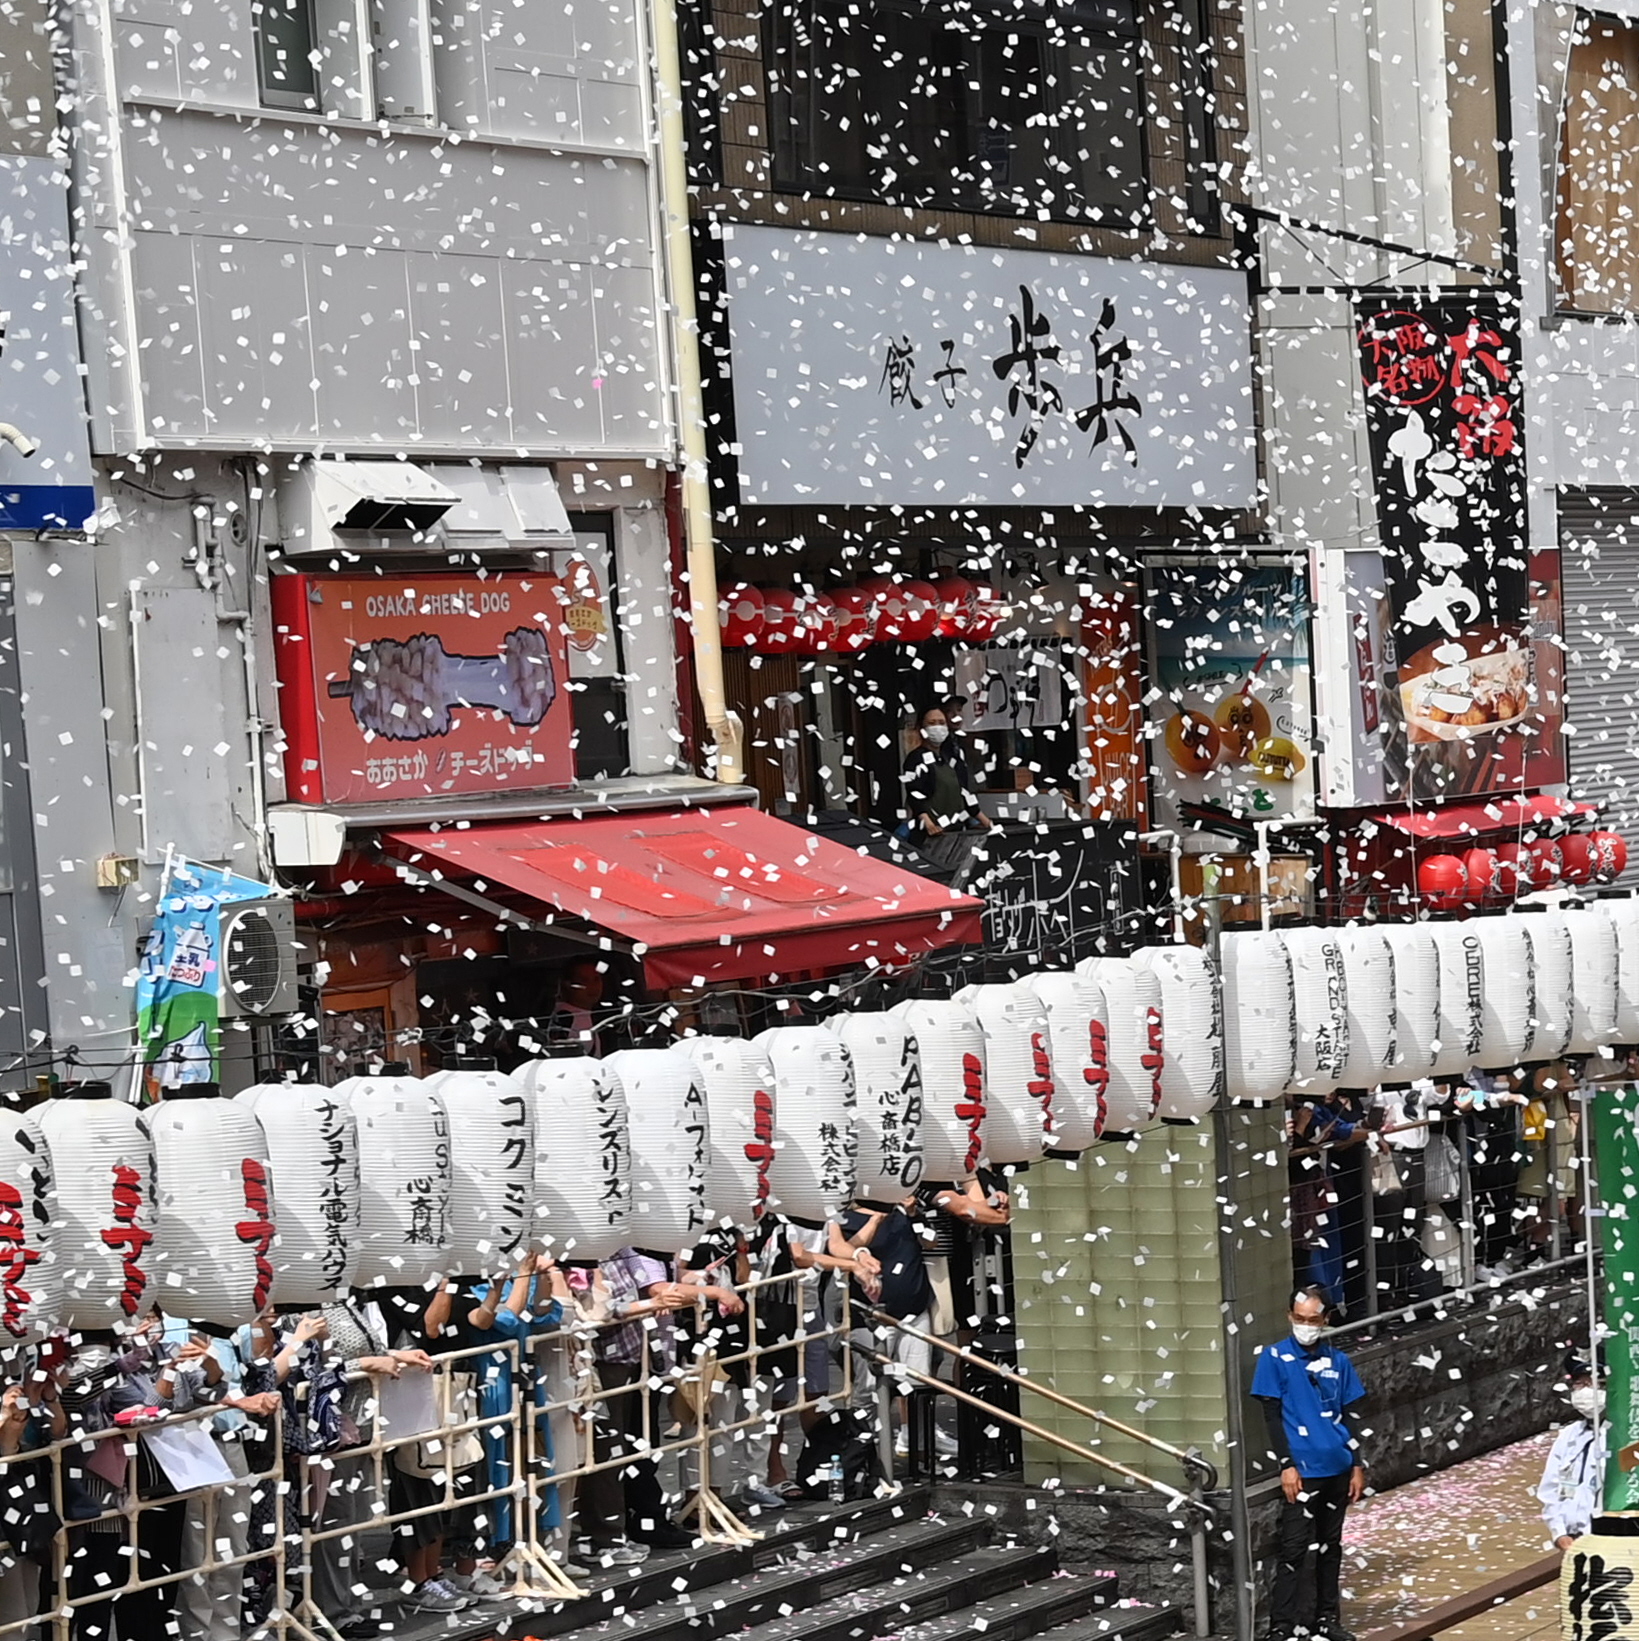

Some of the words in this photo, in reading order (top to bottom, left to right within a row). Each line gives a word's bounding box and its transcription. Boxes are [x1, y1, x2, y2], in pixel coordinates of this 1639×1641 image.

[365, 595, 416, 617] OSAKA
[480, 591, 510, 612] DOG
[366, 749, 429, 784] おおさか
[499, 1096, 526, 1254] コクミン
[900, 1036, 923, 1189] PABLO
[314, 1098, 350, 1291] ナショナル電気ハウス
